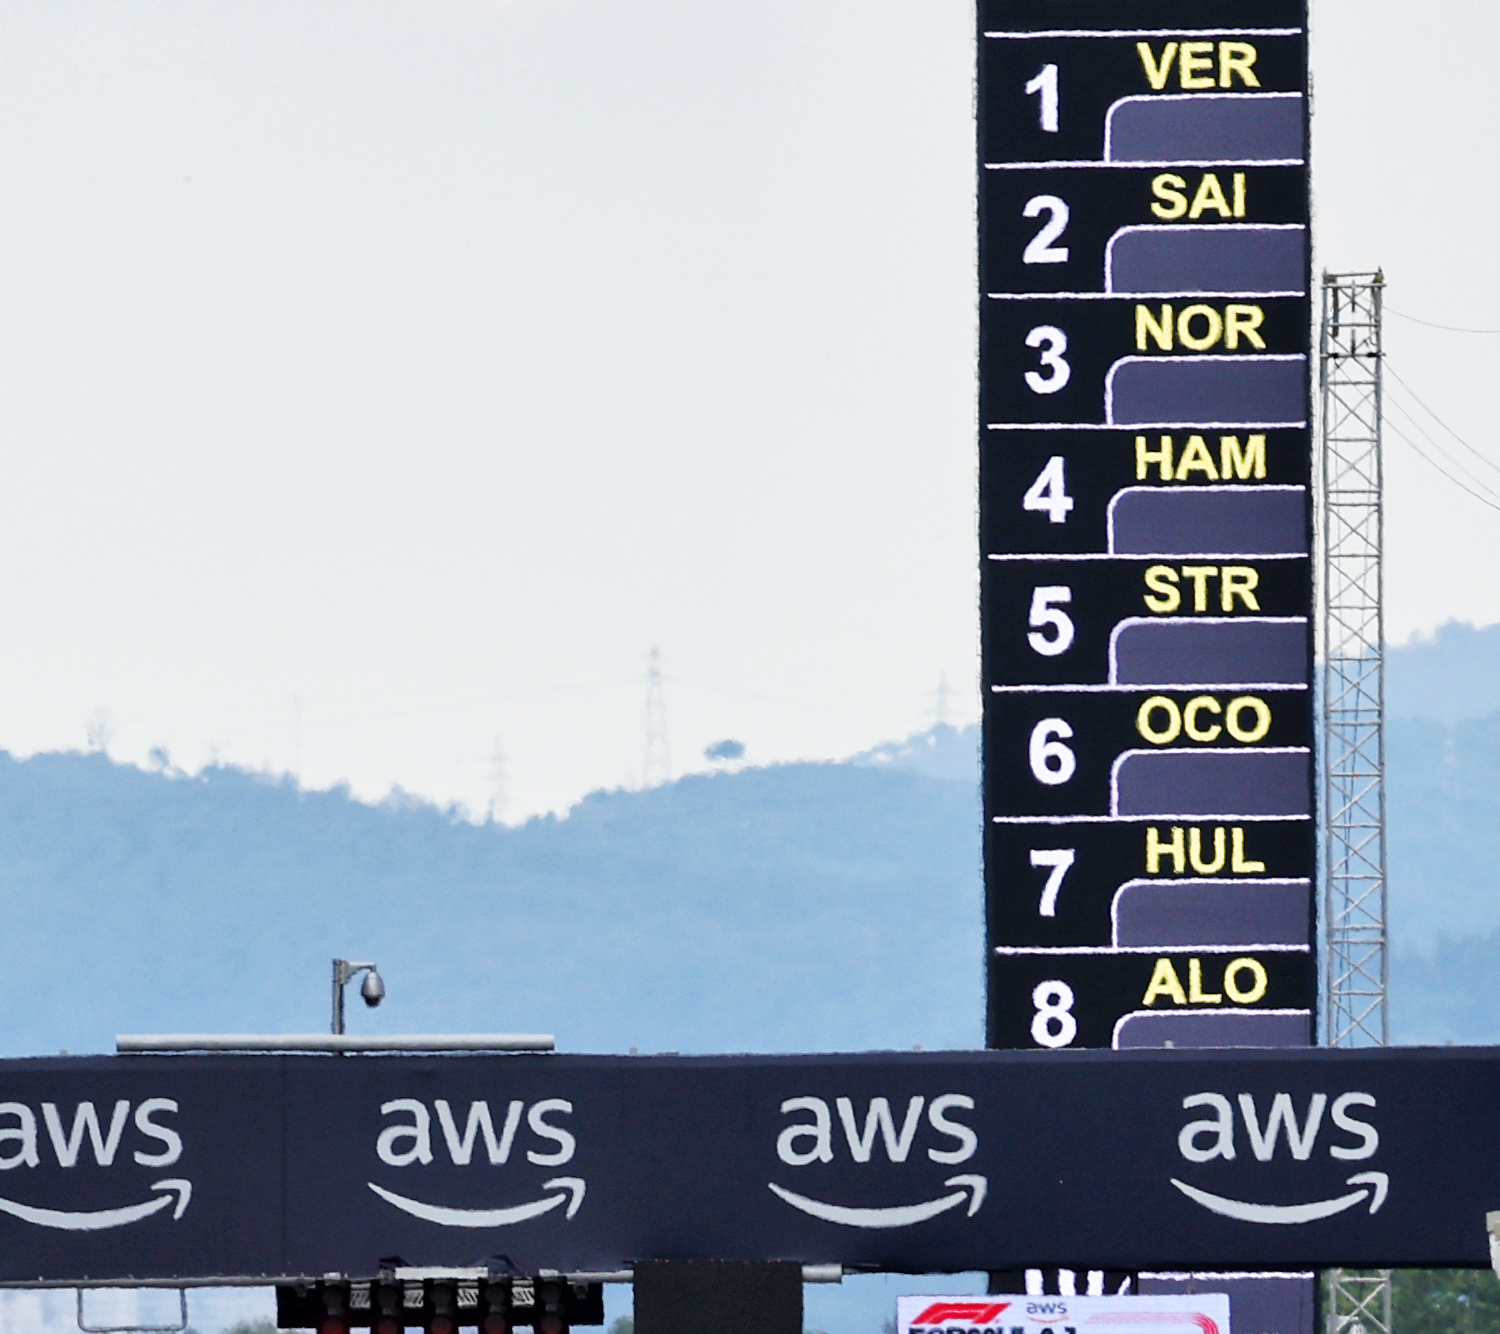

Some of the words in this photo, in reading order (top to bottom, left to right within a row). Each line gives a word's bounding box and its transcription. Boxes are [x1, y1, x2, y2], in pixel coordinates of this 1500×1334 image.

[1026, 64, 1058, 132] 1
[1137, 42, 1260, 89] VER
[1023, 195, 1069, 264] 2
[1151, 173, 1246, 219] SAI
[1025, 325, 1070, 394] 3
[1136, 304, 1266, 350] NOR
[1023, 456, 1073, 522] 4
[1136, 435, 1266, 480] HAM
[1028, 586, 1074, 655] 5
[1144, 565, 1260, 612] STR
[1030, 718, 1075, 785] 6
[1137, 696, 1271, 744] OCO
[1030, 849, 1075, 916] 7
[1147, 826, 1265, 873] HUL
[1031, 981, 1076, 1049] 8
[1143, 958, 1267, 1006] ALO
[377, 1099, 575, 1166] aws
[777, 1094, 977, 1165] aws
[1178, 1092, 1378, 1162] aws
[1027, 1303, 1067, 1314] aws
